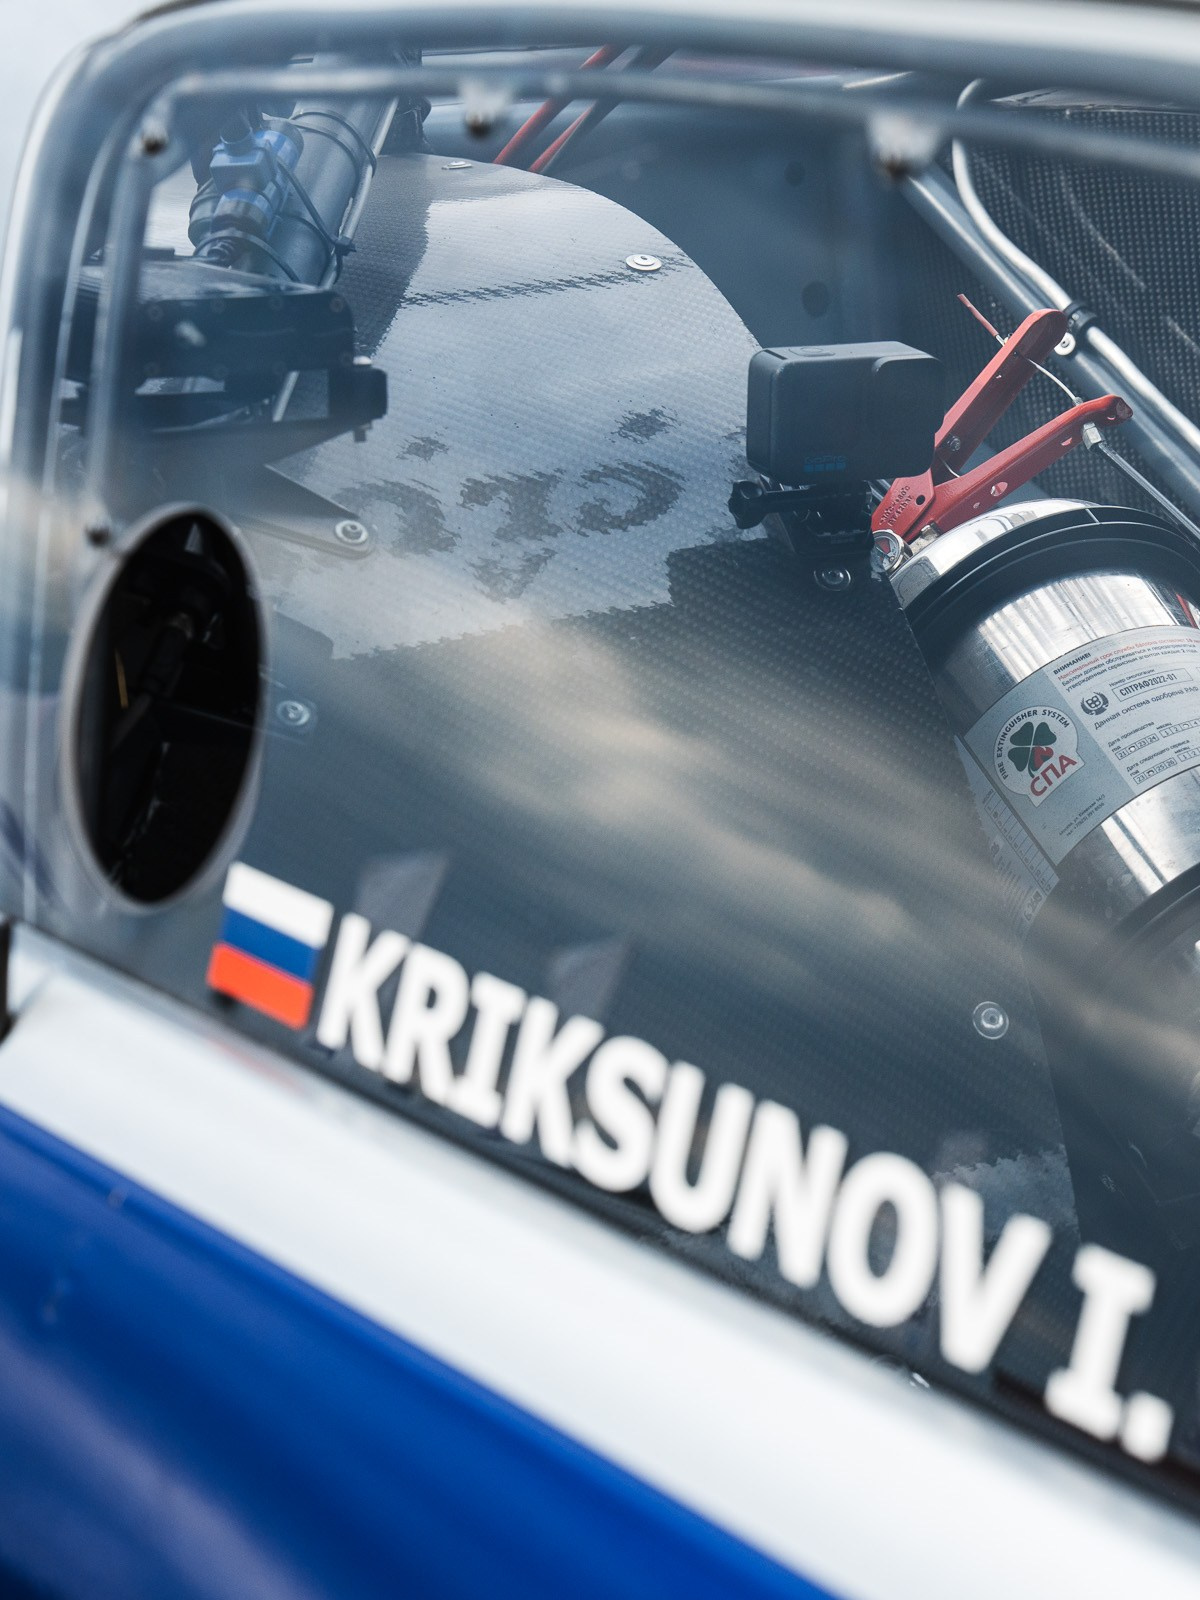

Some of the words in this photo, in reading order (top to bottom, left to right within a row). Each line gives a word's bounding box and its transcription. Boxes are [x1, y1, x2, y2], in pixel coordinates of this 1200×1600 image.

[1053, 652, 1091, 675] ВНИМАНИЕ!
[1100, 653, 1113, 661] срок
[1061, 673, 1083, 687] Баллон
[1109, 678, 1126, 687] Номер
[1119, 673, 1178, 696] СПТРАФ2022-01
[1042, 709, 1070, 728] SYSTEM
[1094, 711, 1121, 730] Данная
[1121, 699, 1151, 715] система
[1151, 689, 1184, 702] одобрена
[997, 709, 1038, 758] EXTINGUISHER
[996, 761, 1009, 780] FIRE
[1030, 754, 1078, 797] СПА
[314, 913, 1051, 1375] KRIKSUNOV
[1045, 1242, 1175, 1464] I.
